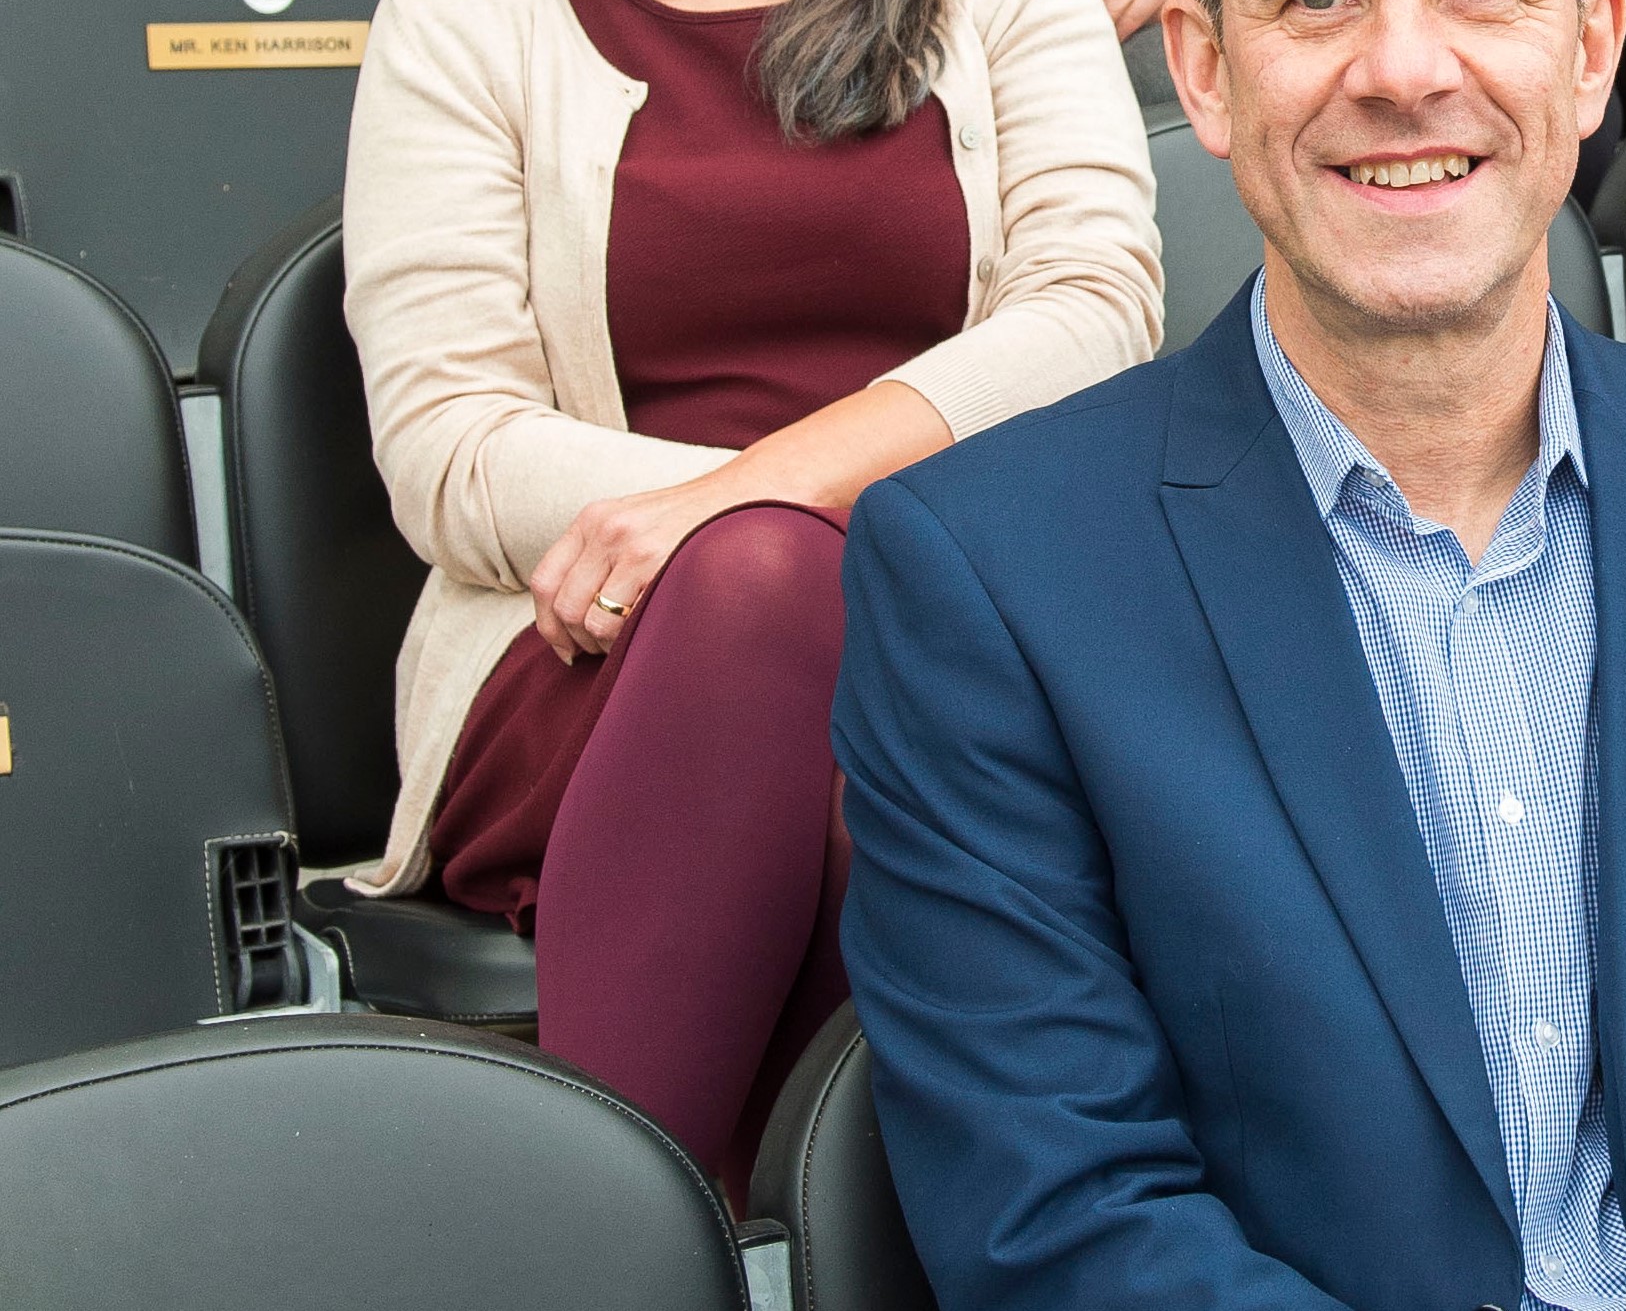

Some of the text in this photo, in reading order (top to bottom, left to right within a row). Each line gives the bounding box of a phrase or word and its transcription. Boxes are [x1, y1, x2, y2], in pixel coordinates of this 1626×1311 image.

[169, 36, 351, 55] MR. KEN HARRISON
